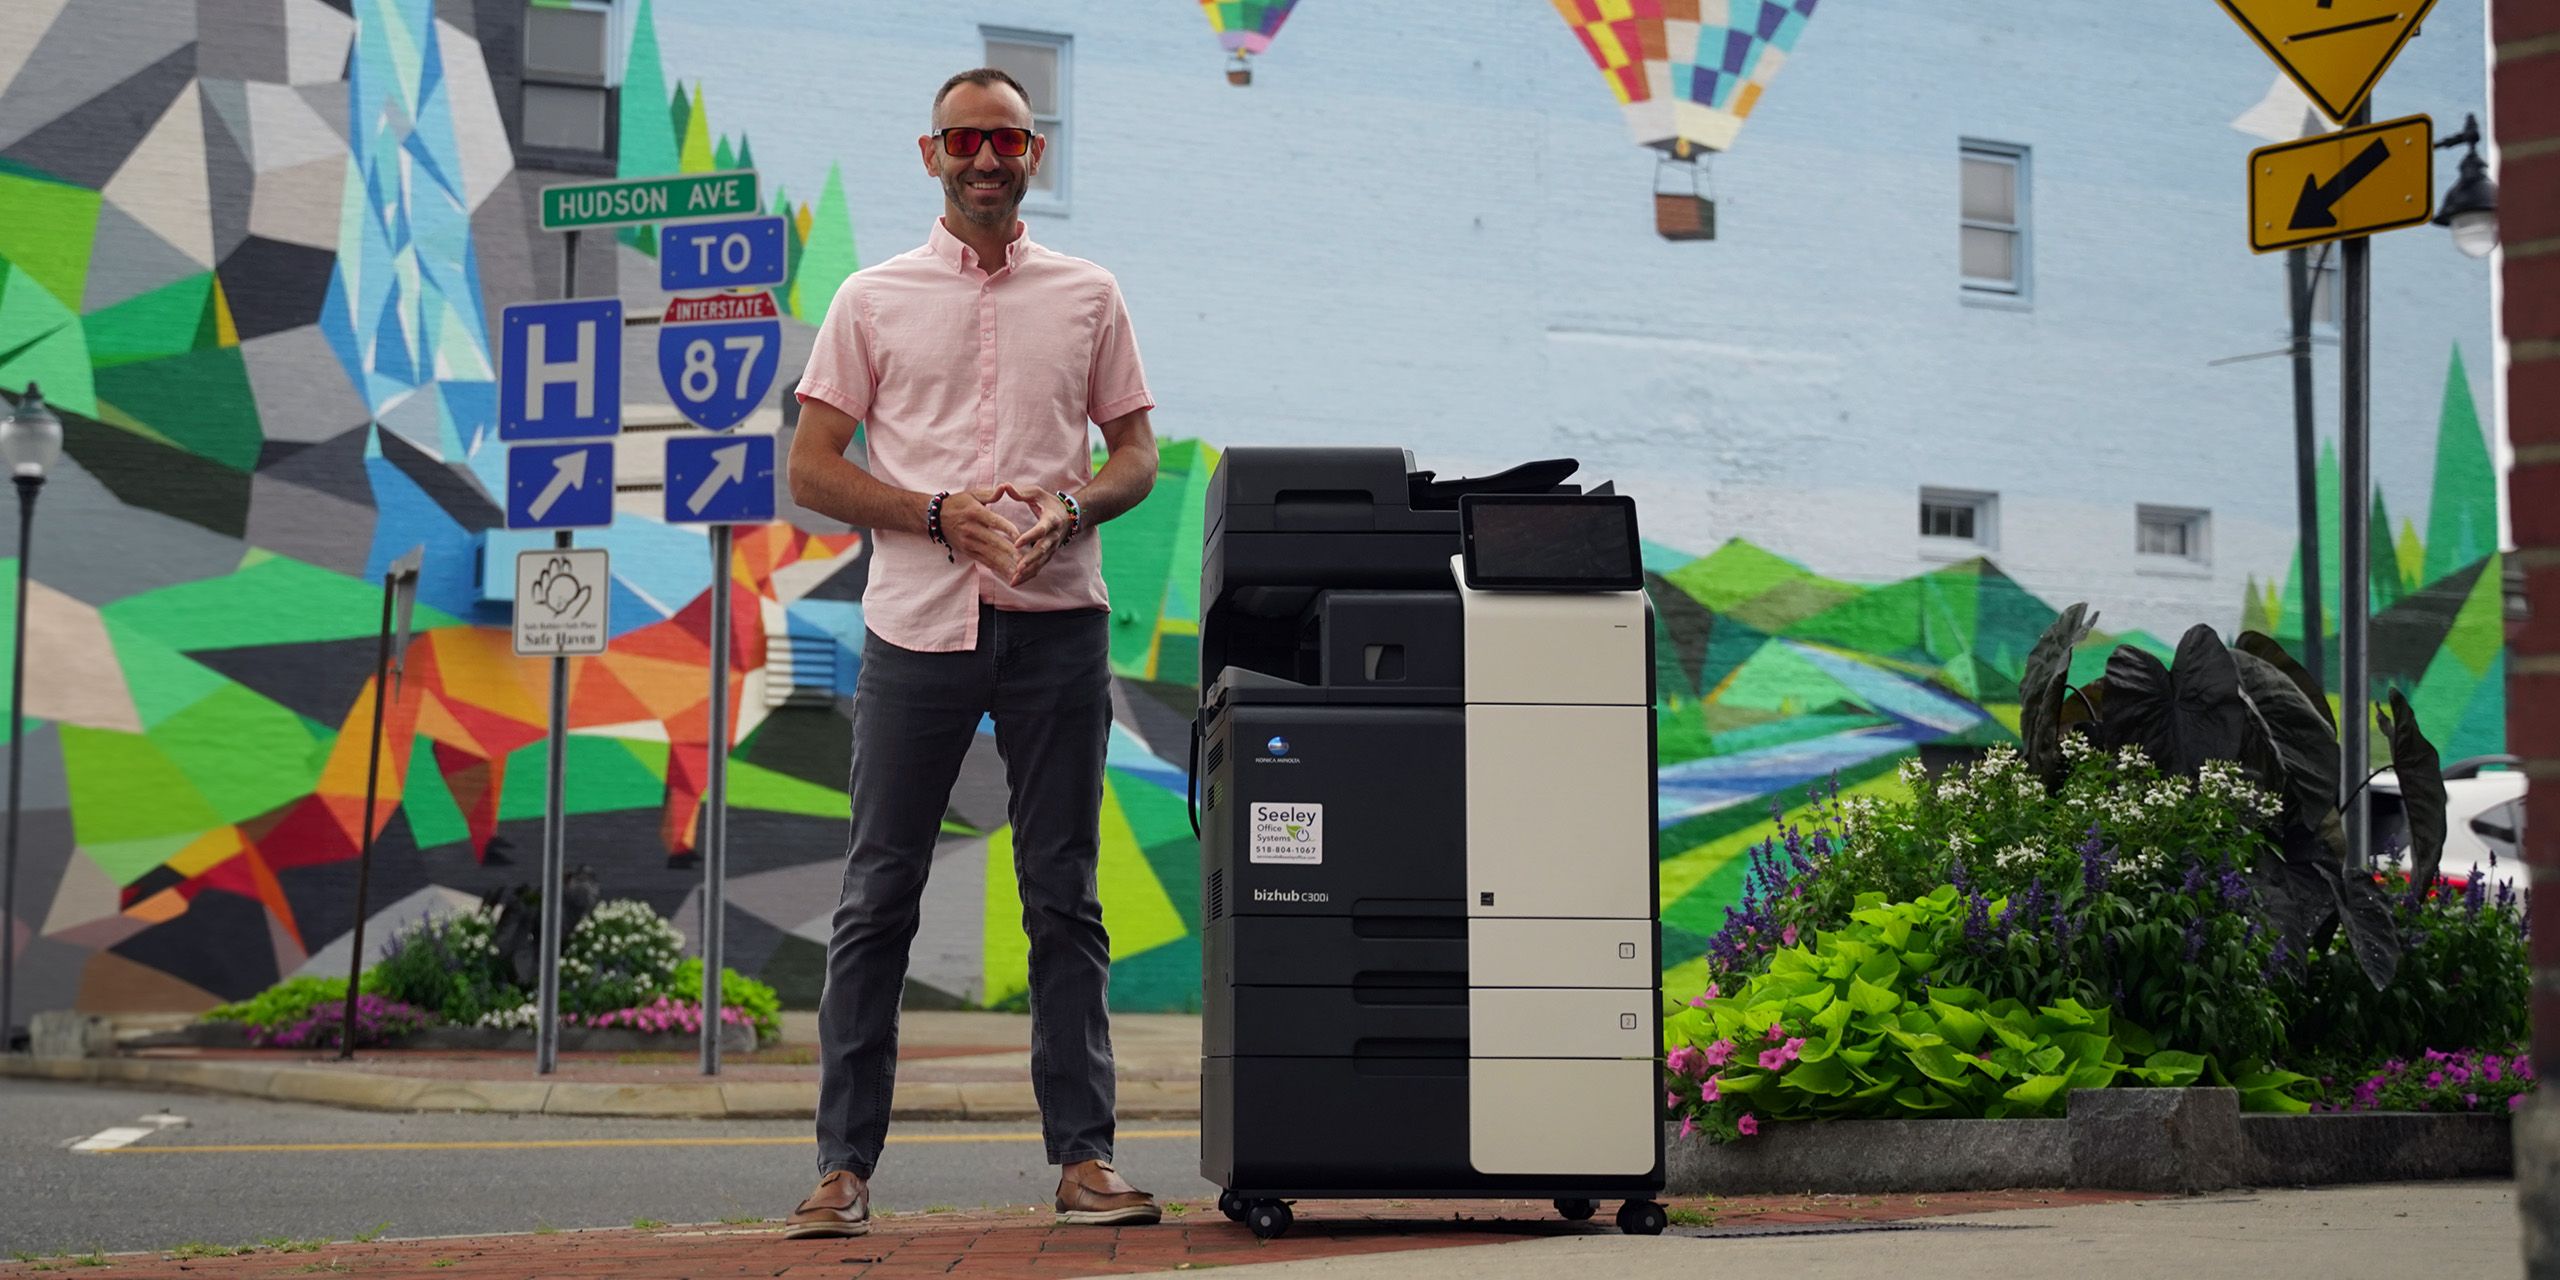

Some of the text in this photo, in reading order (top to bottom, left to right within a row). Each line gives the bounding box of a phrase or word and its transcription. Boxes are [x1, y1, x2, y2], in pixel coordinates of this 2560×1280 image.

[558, 180, 740, 220] HUDSON AVE
[691, 233, 752, 275] TO
[676, 299, 763, 321] INTERSTATE
[525, 320, 597, 421] H
[680, 335, 765, 403] 87
[525, 632, 596, 646] Safe Haven
[1258, 806, 1316, 827] Seeley
[1256, 833, 1291, 843] Systems
[1257, 824, 1282, 832] Office
[1254, 888, 1329, 902] bizhub C300i
